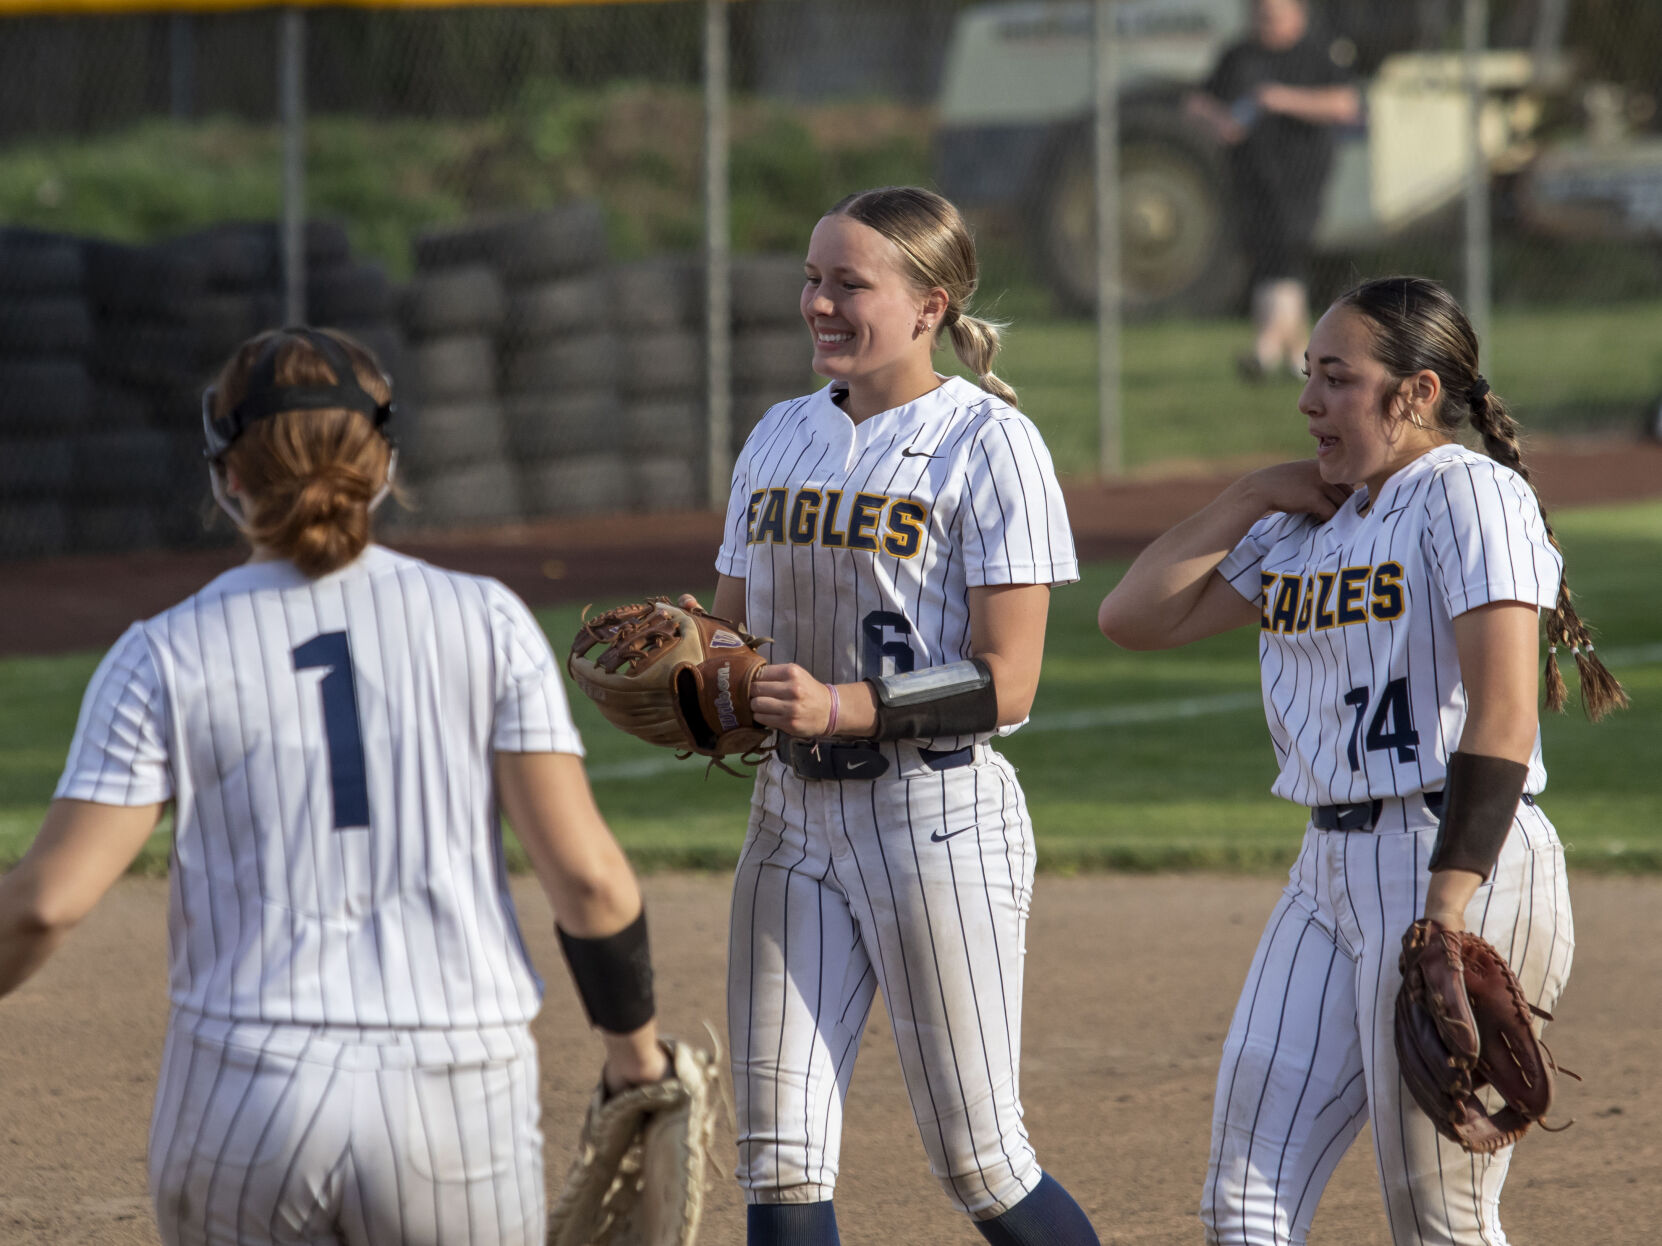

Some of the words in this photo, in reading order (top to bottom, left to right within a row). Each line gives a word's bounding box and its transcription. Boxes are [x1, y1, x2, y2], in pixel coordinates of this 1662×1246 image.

[746, 487, 927, 560] EAGLES
[1261, 560, 1405, 635] EAGLES
[862, 611, 914, 678] 6
[292, 630, 370, 830] 1
[1345, 677, 1420, 772] 14
